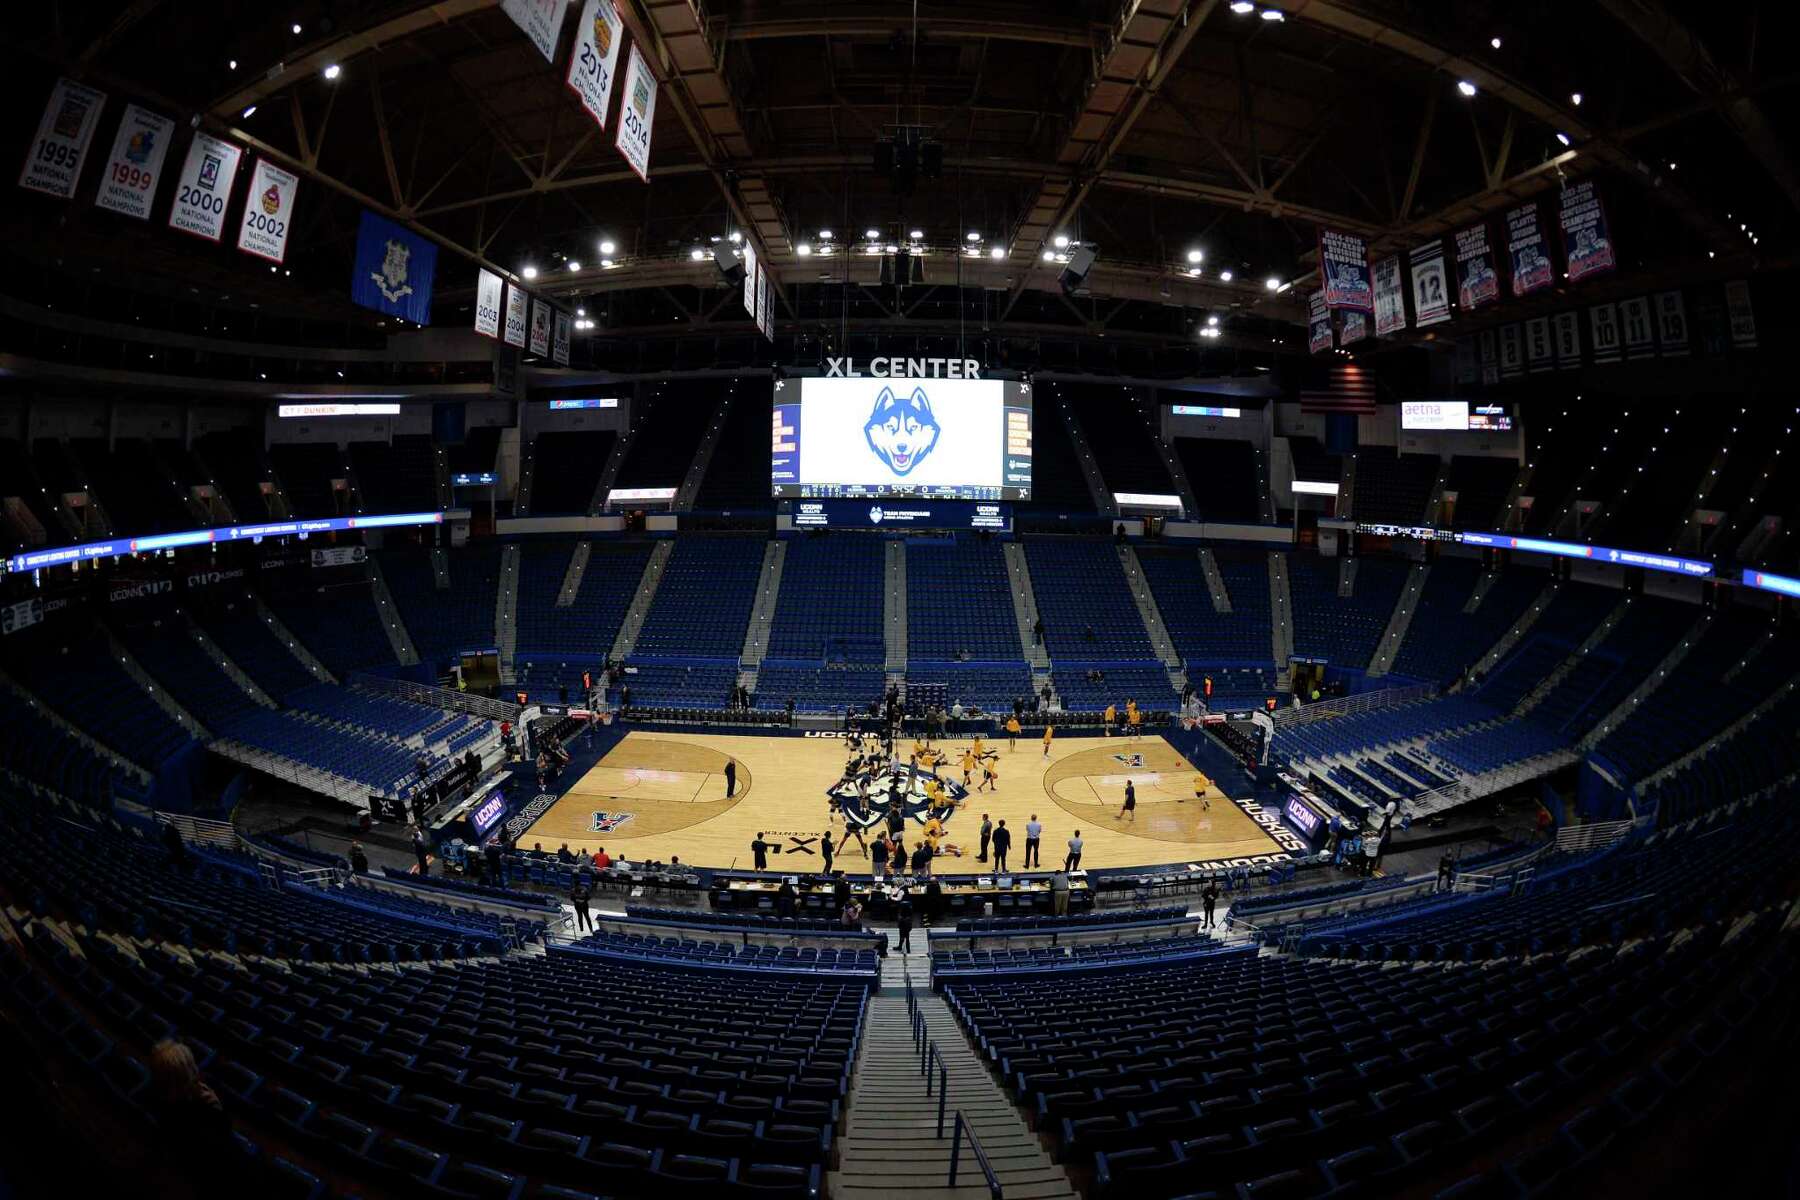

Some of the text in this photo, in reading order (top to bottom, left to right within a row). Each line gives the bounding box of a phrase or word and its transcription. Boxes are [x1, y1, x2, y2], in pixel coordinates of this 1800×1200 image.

[580, 42, 608, 92] 2013
[625, 107, 648, 149] 2014
[37, 139, 79, 169] 1995
[111, 162, 152, 190] 1999
[102, 196, 146, 215] CHAMPIONS
[108, 185, 145, 203] NATIONAL
[179, 185, 223, 214] 2000
[175, 218, 216, 236] CHAMPIONS
[181, 207, 214, 225] NATIONAL
[247, 210, 285, 238] 2002
[243, 240, 279, 258] CHAMPIONS
[248, 231, 278, 247] NATIONAL
[1419, 276, 1442, 305] 12
[478, 304, 497, 322] 2003
[507, 317, 525, 332] 2004
[826, 356, 980, 379] XL CENTER
[1404, 403, 1441, 415] aetna
[474, 796, 502, 826] UCONN
[1287, 798, 1318, 829] UCONN
[1236, 798, 1307, 852] HUSKIES
